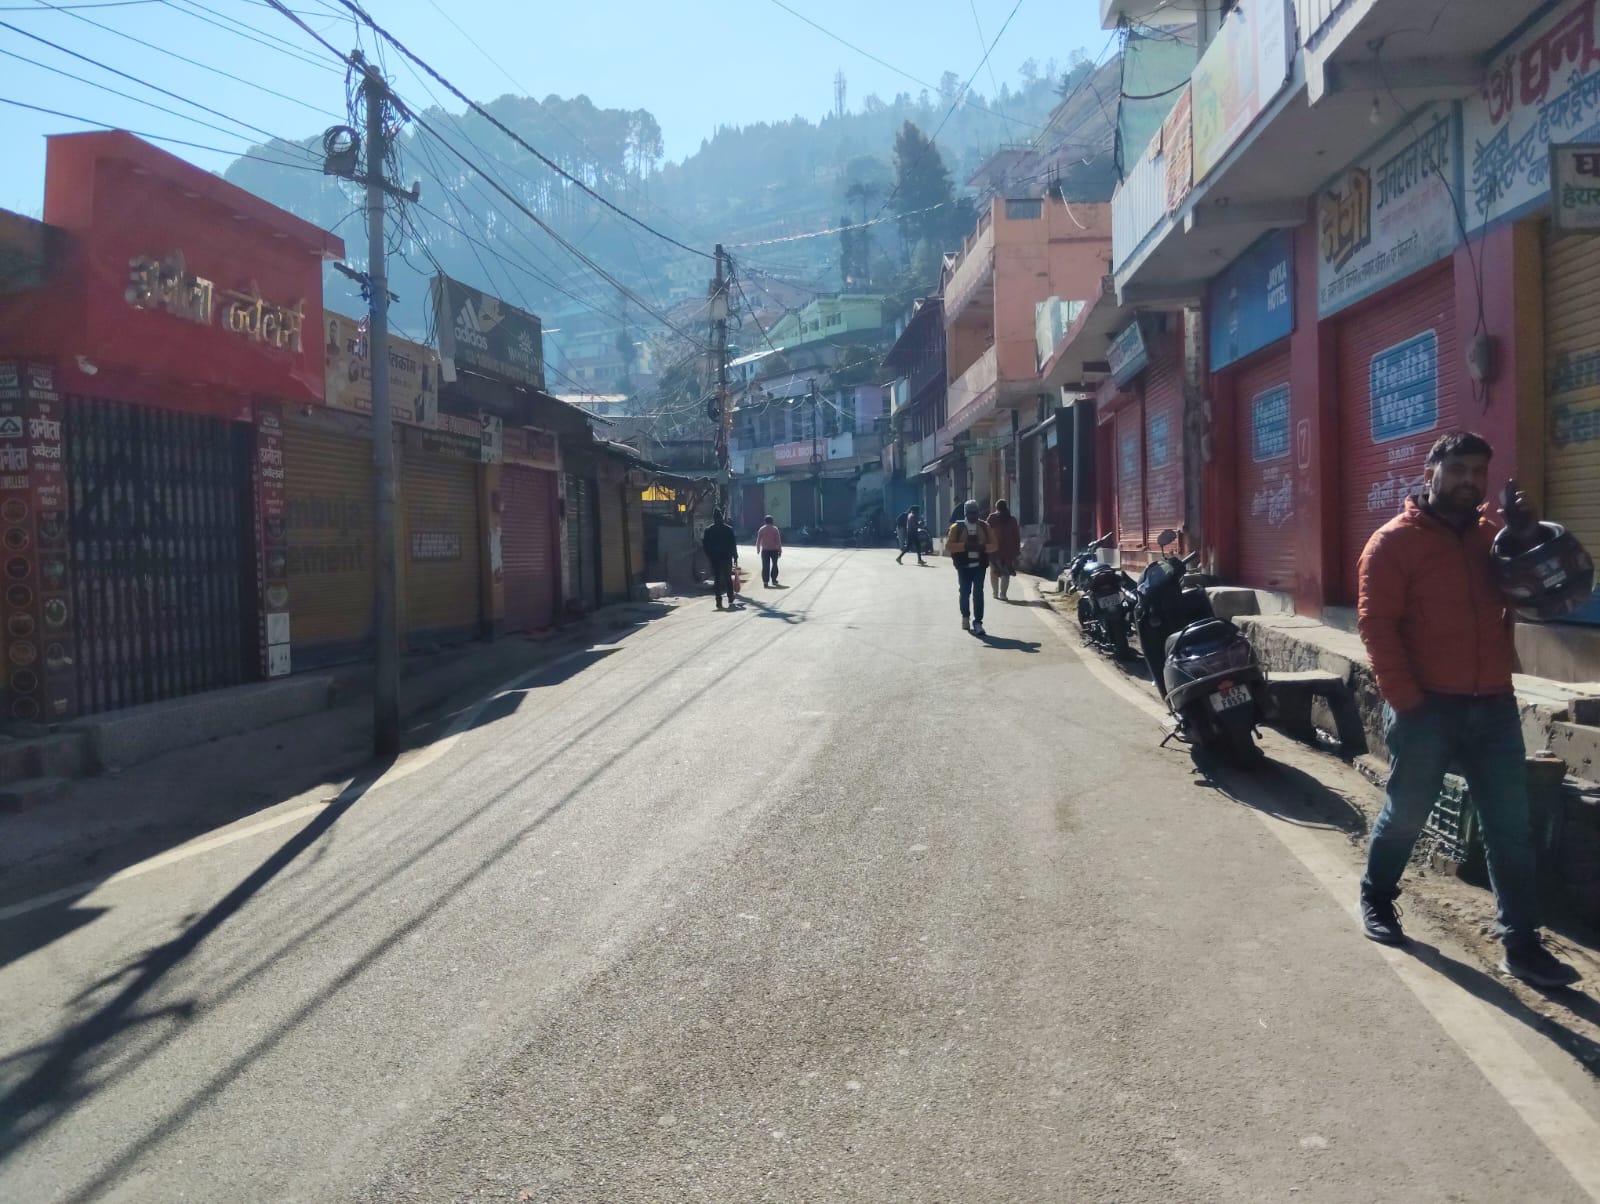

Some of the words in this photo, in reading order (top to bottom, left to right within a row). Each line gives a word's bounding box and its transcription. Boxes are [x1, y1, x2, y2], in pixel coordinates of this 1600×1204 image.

[454, 326, 489, 351] adidas
[1375, 343, 1430, 394] Health
[1379, 390, 1425, 431] Ways
